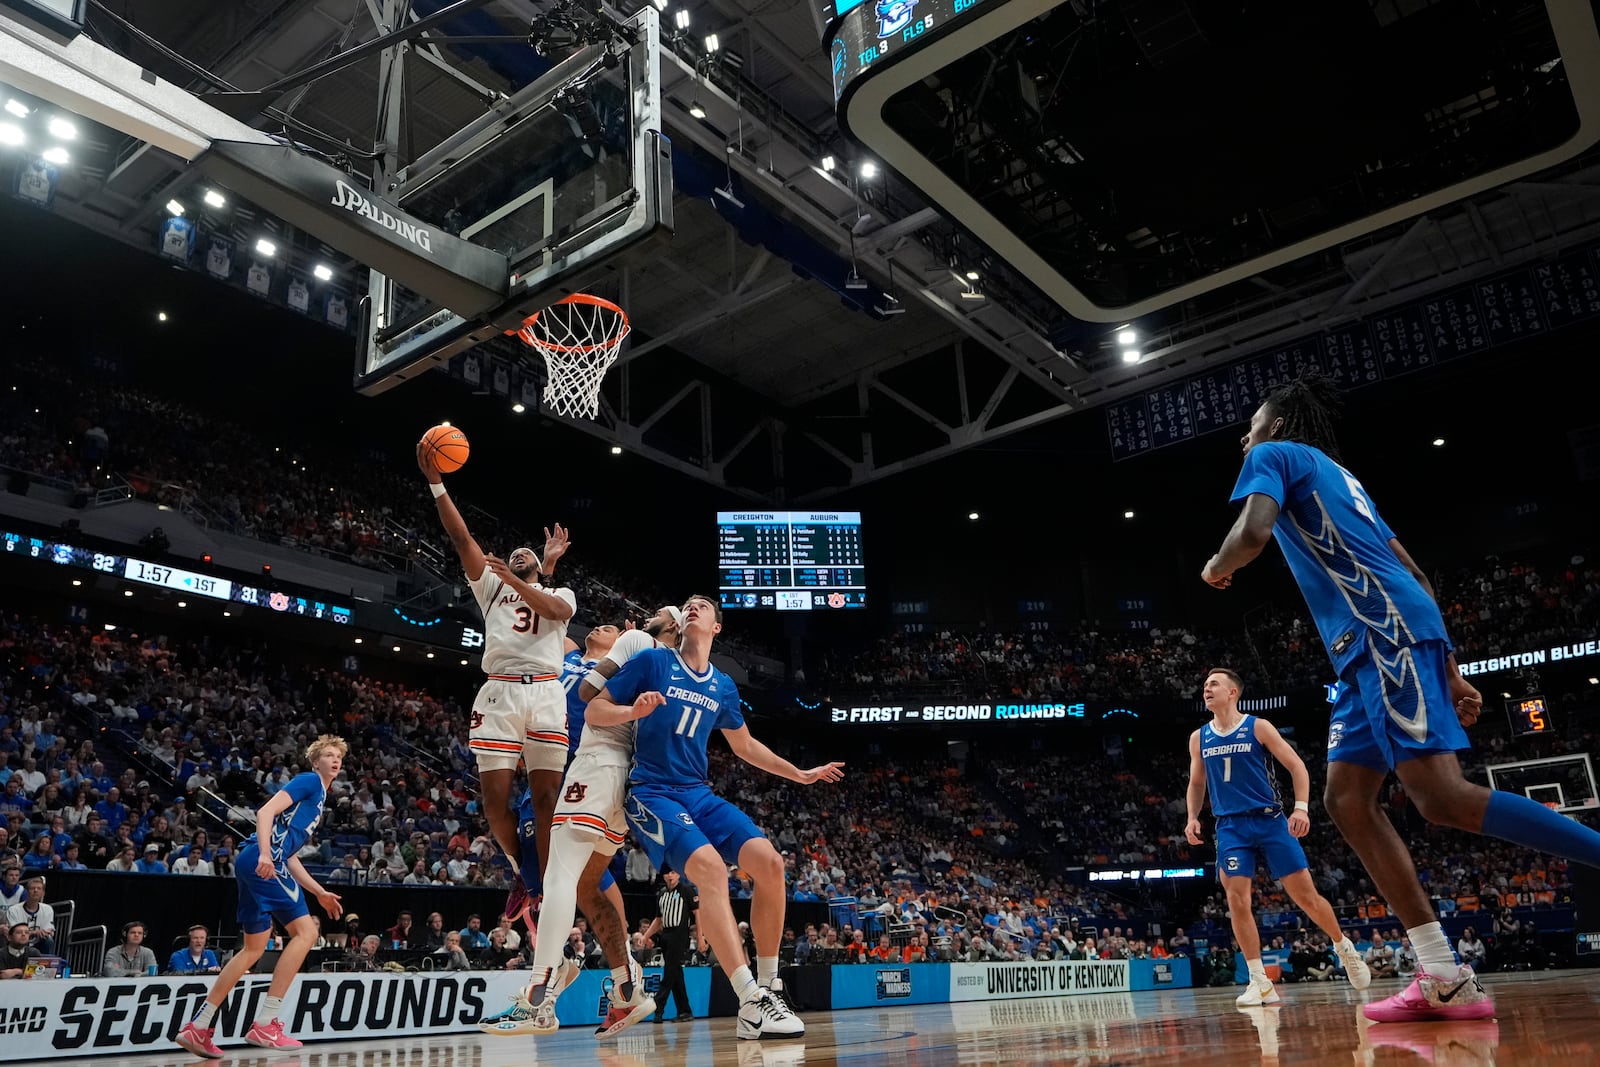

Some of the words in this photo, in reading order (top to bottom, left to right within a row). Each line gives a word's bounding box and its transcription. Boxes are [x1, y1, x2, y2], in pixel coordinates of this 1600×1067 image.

[903, 20, 924, 43] FLS
[924, 14, 934, 28] 5
[878, 39, 889, 53] 3
[331, 179, 432, 253] SPALDING
[1537, 265, 1564, 313] NCAA
[1481, 283, 1504, 332] NCAA
[1426, 303, 1448, 348] NCAA
[1324, 335, 1344, 378] NCAA
[1376, 319, 1397, 365] NCAA
[1192, 379, 1208, 421] NCAA
[1235, 365, 1253, 406] NCAA
[1109, 407, 1124, 448] NCAA
[1149, 392, 1164, 434] NCAA
[6, 540, 15, 552] 5
[30, 546, 39, 557] 3
[92, 553, 115, 573] 32
[137, 562, 173, 585] 1:57
[194, 577, 217, 593] 1ST
[240, 585, 258, 604] 31
[761, 595, 774, 606] 32
[785, 599, 803, 608] 1:57
[814, 595, 826, 606] 31
[512, 606, 540, 635] 31
[1458, 649, 1546, 677] REIGHTON
[666, 685, 720, 713] CREIGHTON
[850, 706, 903, 723] FIRST
[922, 705, 991, 721] SECOND
[995, 703, 1066, 719] ROUNDS
[1520, 699, 1544, 713] 1:57
[675, 705, 702, 739] 11
[1529, 710, 1544, 731] 5
[1202, 742, 1252, 759] CREIGHTON
[1222, 756, 1232, 783] 1
[882, 971, 902, 983] MARCH
[885, 982, 911, 994] MADNESS
[957, 976, 976, 987] HOSTED
[977, 975, 985, 985] BY
[987, 966, 1055, 994] UNIVERSITY
[1059, 966, 1072, 990] OF
[1075, 963, 1125, 989] KENTUCKY
[297, 976, 488, 1034] ROUNDS
